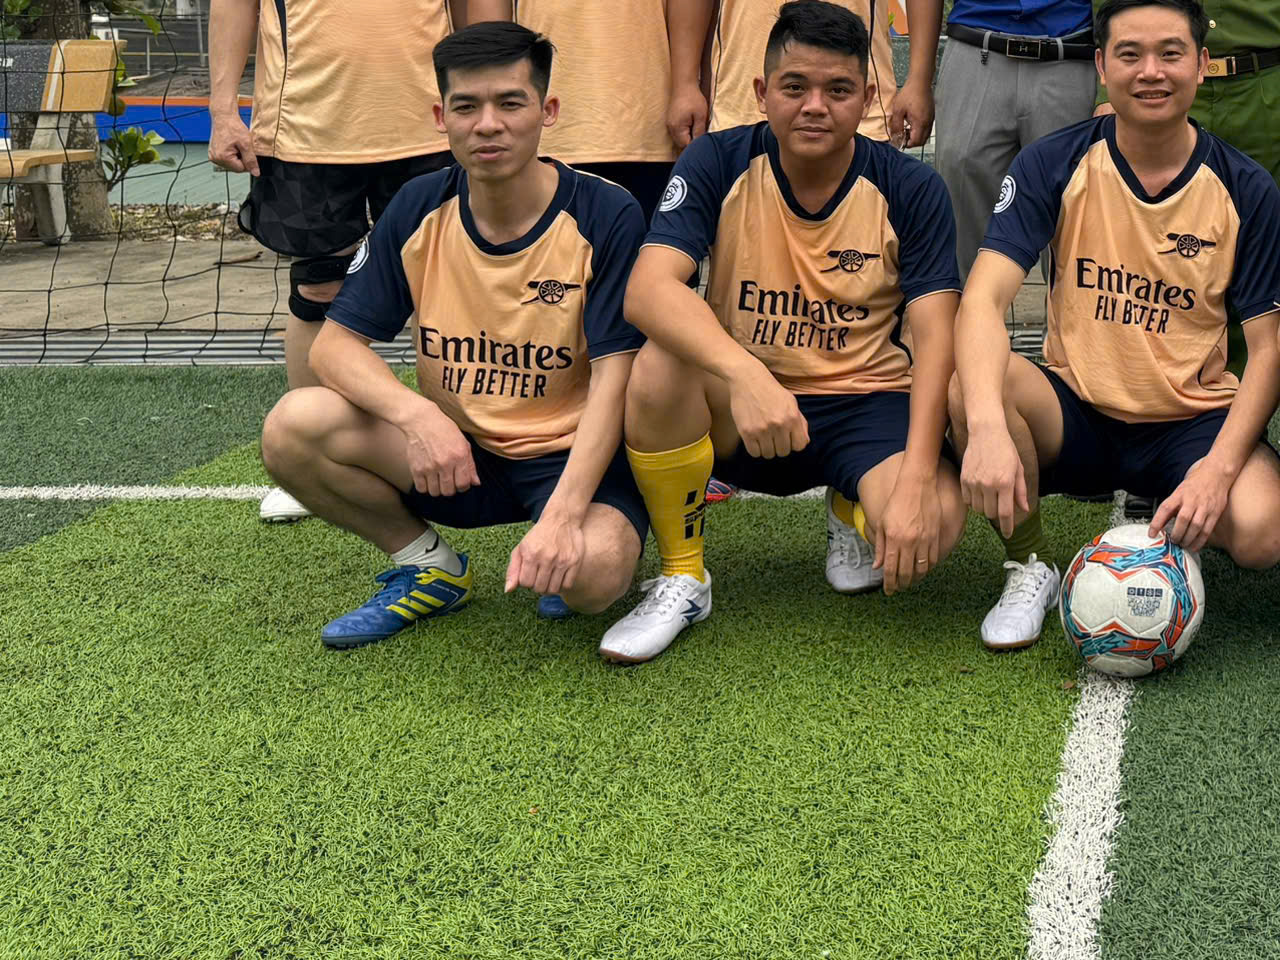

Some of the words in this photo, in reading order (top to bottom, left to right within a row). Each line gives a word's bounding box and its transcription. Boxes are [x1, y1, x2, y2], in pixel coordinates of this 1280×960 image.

[1094, 294, 1118, 322] FLY
[418, 326, 573, 371] Emirates
[752, 318, 781, 345] FLY
[785, 321, 850, 351] BETTER
[443, 364, 466, 394] FLY
[471, 368, 547, 399] BETTER
